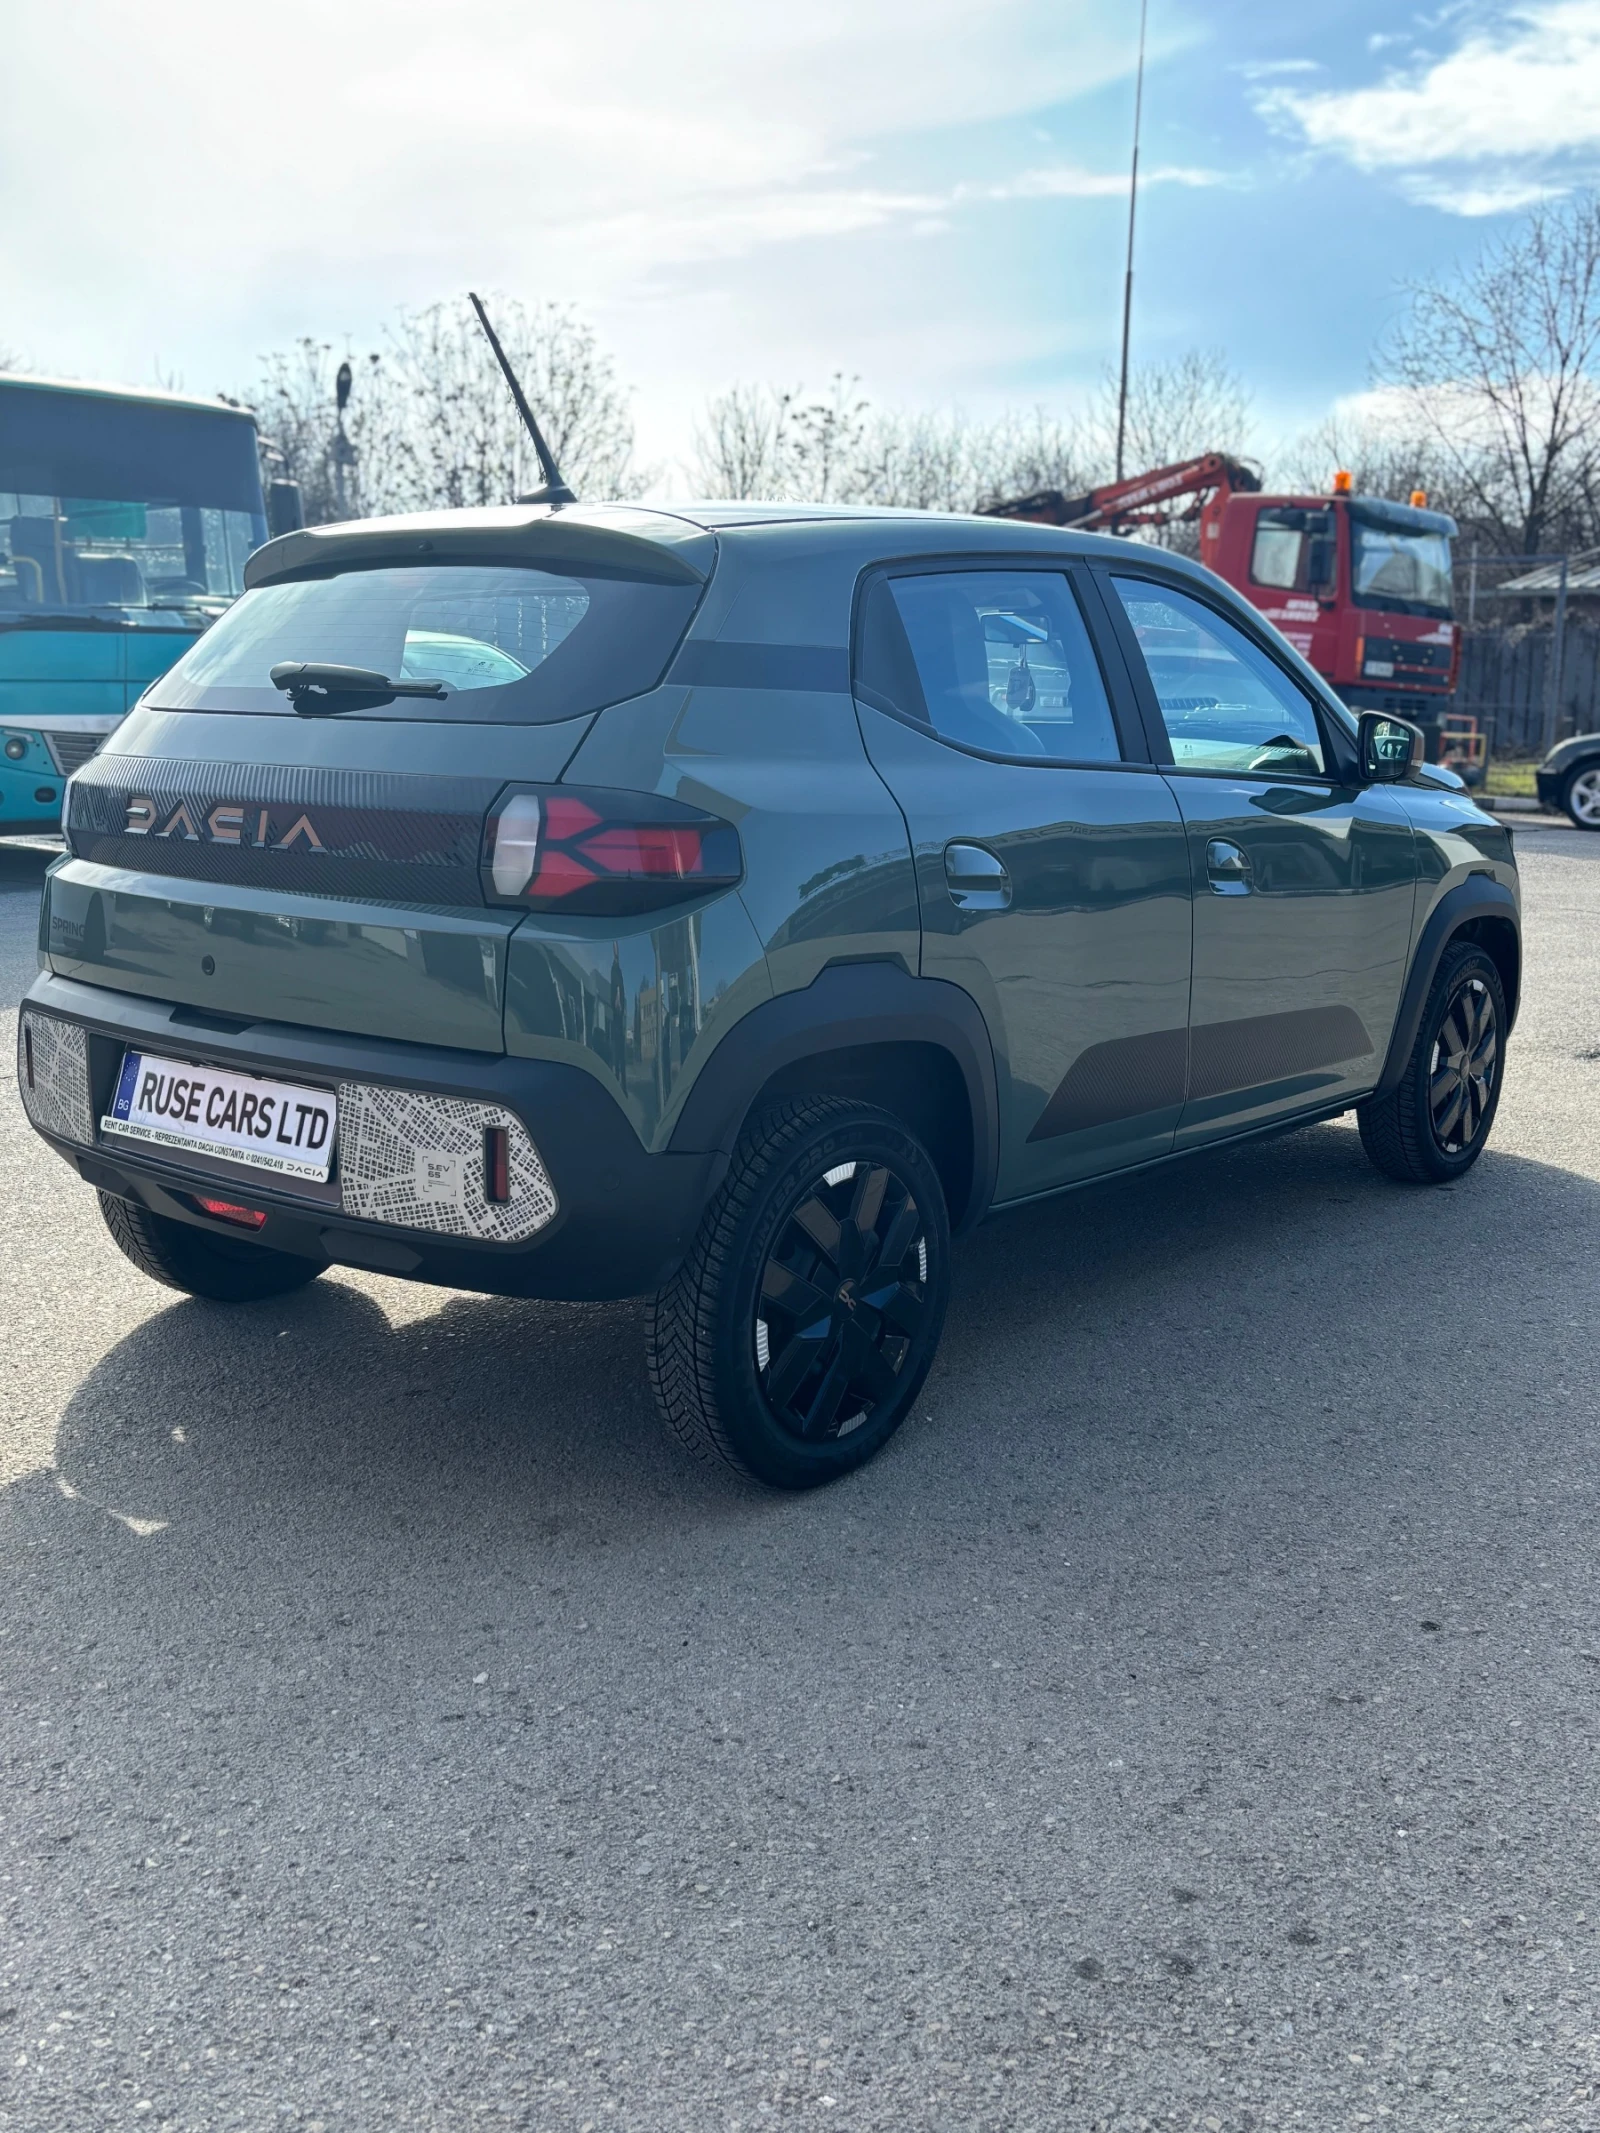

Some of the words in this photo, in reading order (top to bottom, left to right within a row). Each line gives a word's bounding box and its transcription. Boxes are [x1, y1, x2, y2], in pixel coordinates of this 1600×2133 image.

[124, 794, 328, 853] DACIA
[117, 1098, 130, 1111] BG
[138, 1071, 206, 1124] RUSE
[206, 1086, 275, 1139] CARS
[276, 1100, 329, 1150] LTD
[104, 1119, 118, 1131] RENT
[118, 1123, 129, 1134] CAR
[129, 1126, 152, 1139] SERVICE
[154, 1132, 198, 1149] REPREZENTANTA
[198, 1142, 214, 1153] DACIA
[214, 1145, 245, 1161] CONSTANTA
[798, 1138, 835, 1176] PRO
[286, 1163, 324, 1178] DACIA
